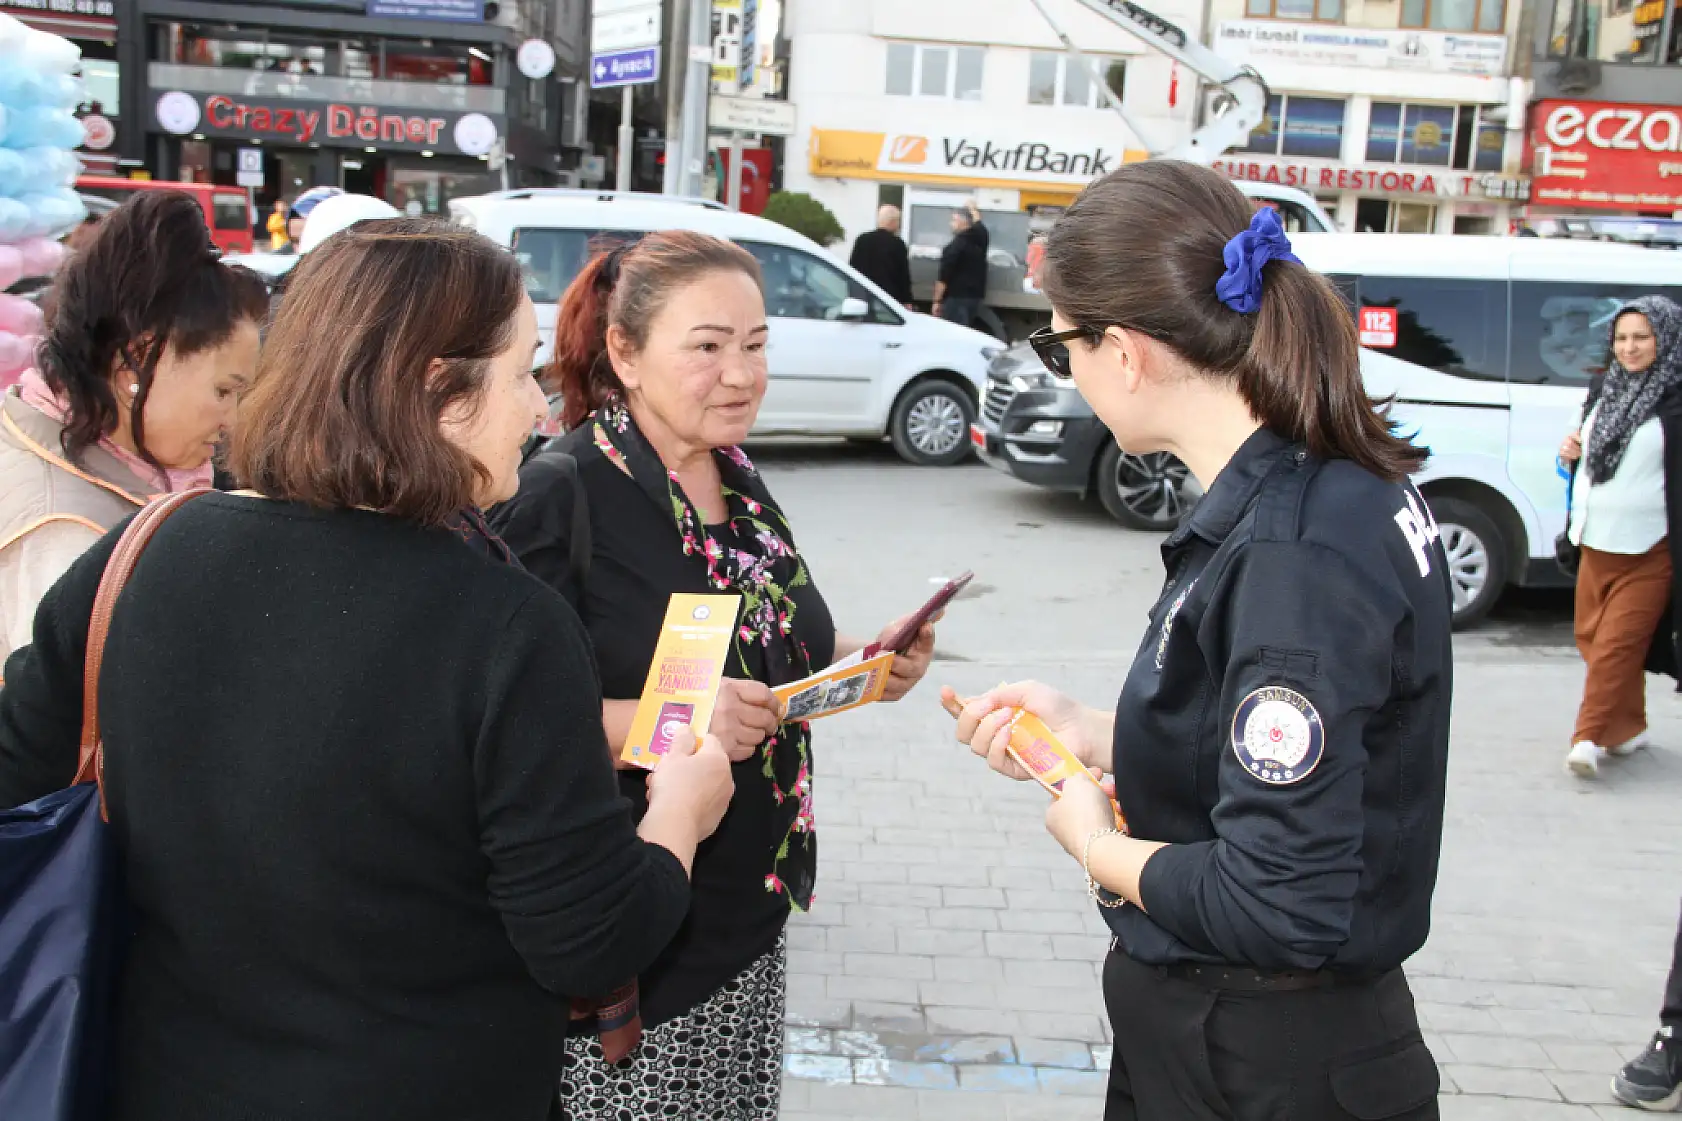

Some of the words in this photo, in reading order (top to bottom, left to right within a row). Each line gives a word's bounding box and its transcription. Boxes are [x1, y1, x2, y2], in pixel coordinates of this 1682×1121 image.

[206, 95, 319, 142] Crazy
[326, 103, 447, 144] Döner
[943, 136, 1113, 176] VakıfBank
[1364, 311, 1392, 330] 112
[1258, 689, 1307, 712] SAMSUN
